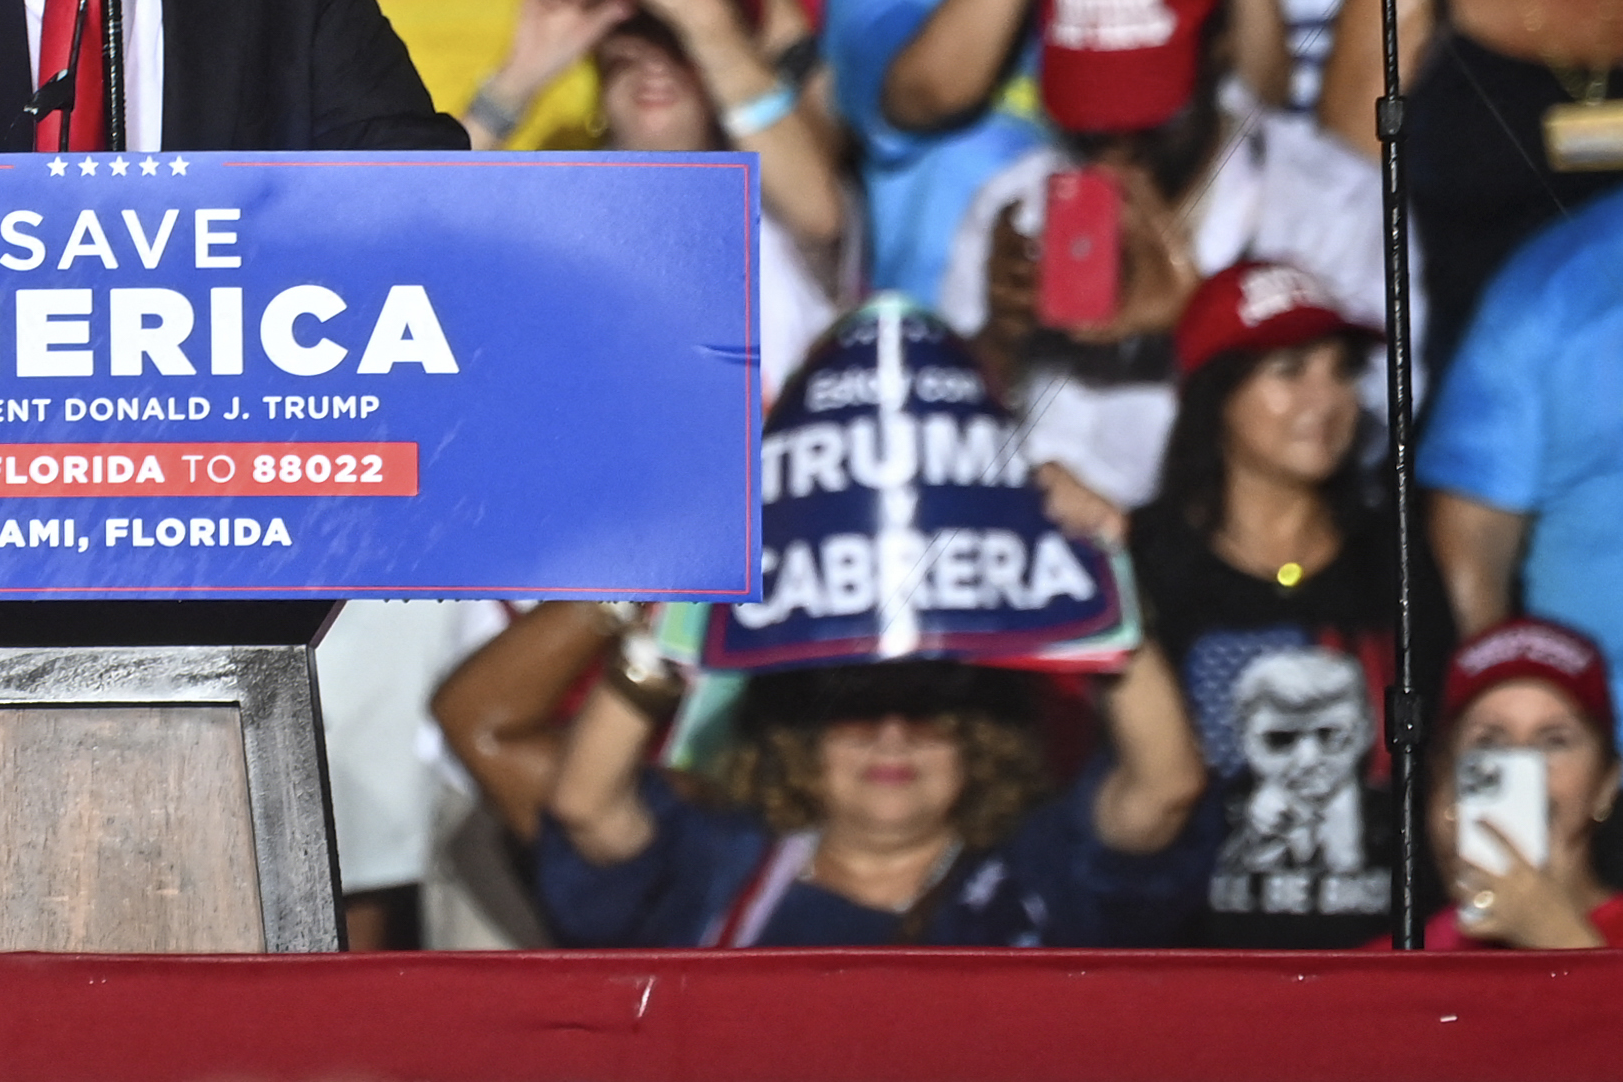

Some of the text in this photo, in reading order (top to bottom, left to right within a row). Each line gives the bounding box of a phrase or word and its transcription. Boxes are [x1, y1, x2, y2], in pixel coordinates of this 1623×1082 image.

[63, 395, 211, 422] DONALD
[222, 396, 250, 421] J.
[262, 394, 381, 421] TRUMP
[181, 454, 237, 484] TO
[251, 453, 384, 484] 88022
[104, 517, 293, 548] FLORIDA
